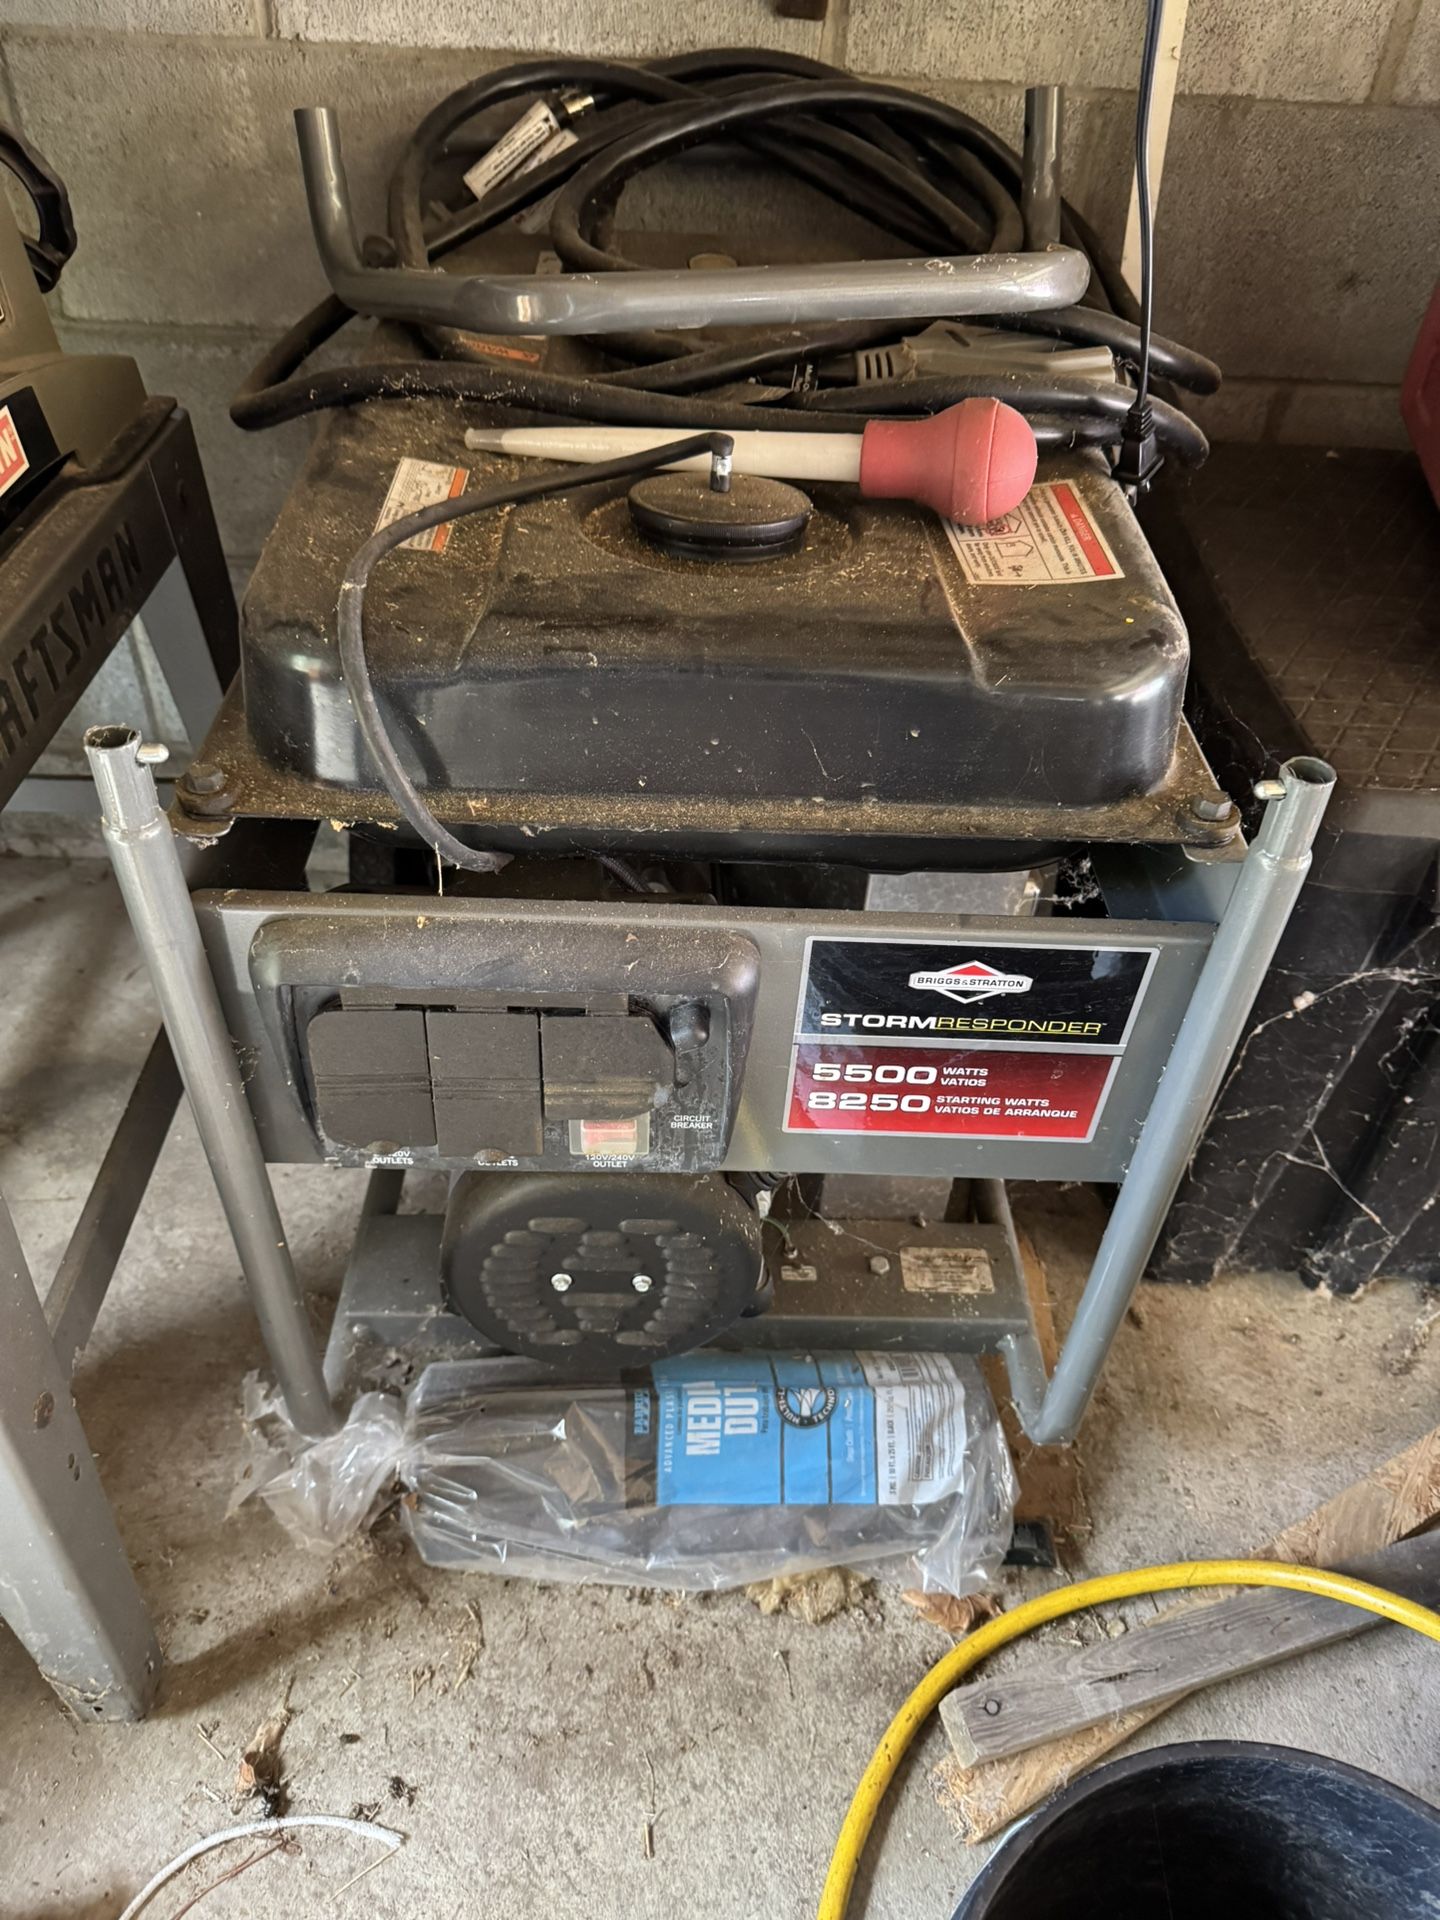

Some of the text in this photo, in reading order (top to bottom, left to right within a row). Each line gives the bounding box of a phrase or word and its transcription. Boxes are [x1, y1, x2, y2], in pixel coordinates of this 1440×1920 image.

[812, 1063, 988, 1085] 5500 WATTS
[940, 1077, 987, 1087] VATIOS
[808, 1091, 1050, 1113] 8250 STARTING WATTS
[934, 1105, 1078, 1119] VATIOS DE ARRANQUE
[670, 1121, 713, 1129] BREAKER
[585, 1154, 635, 1162] 120V/240V
[778, 1387, 800, 1425] MULTI-L
[812, 1389, 835, 1424] TECHNO
[682, 1383, 722, 1456] MEDI
